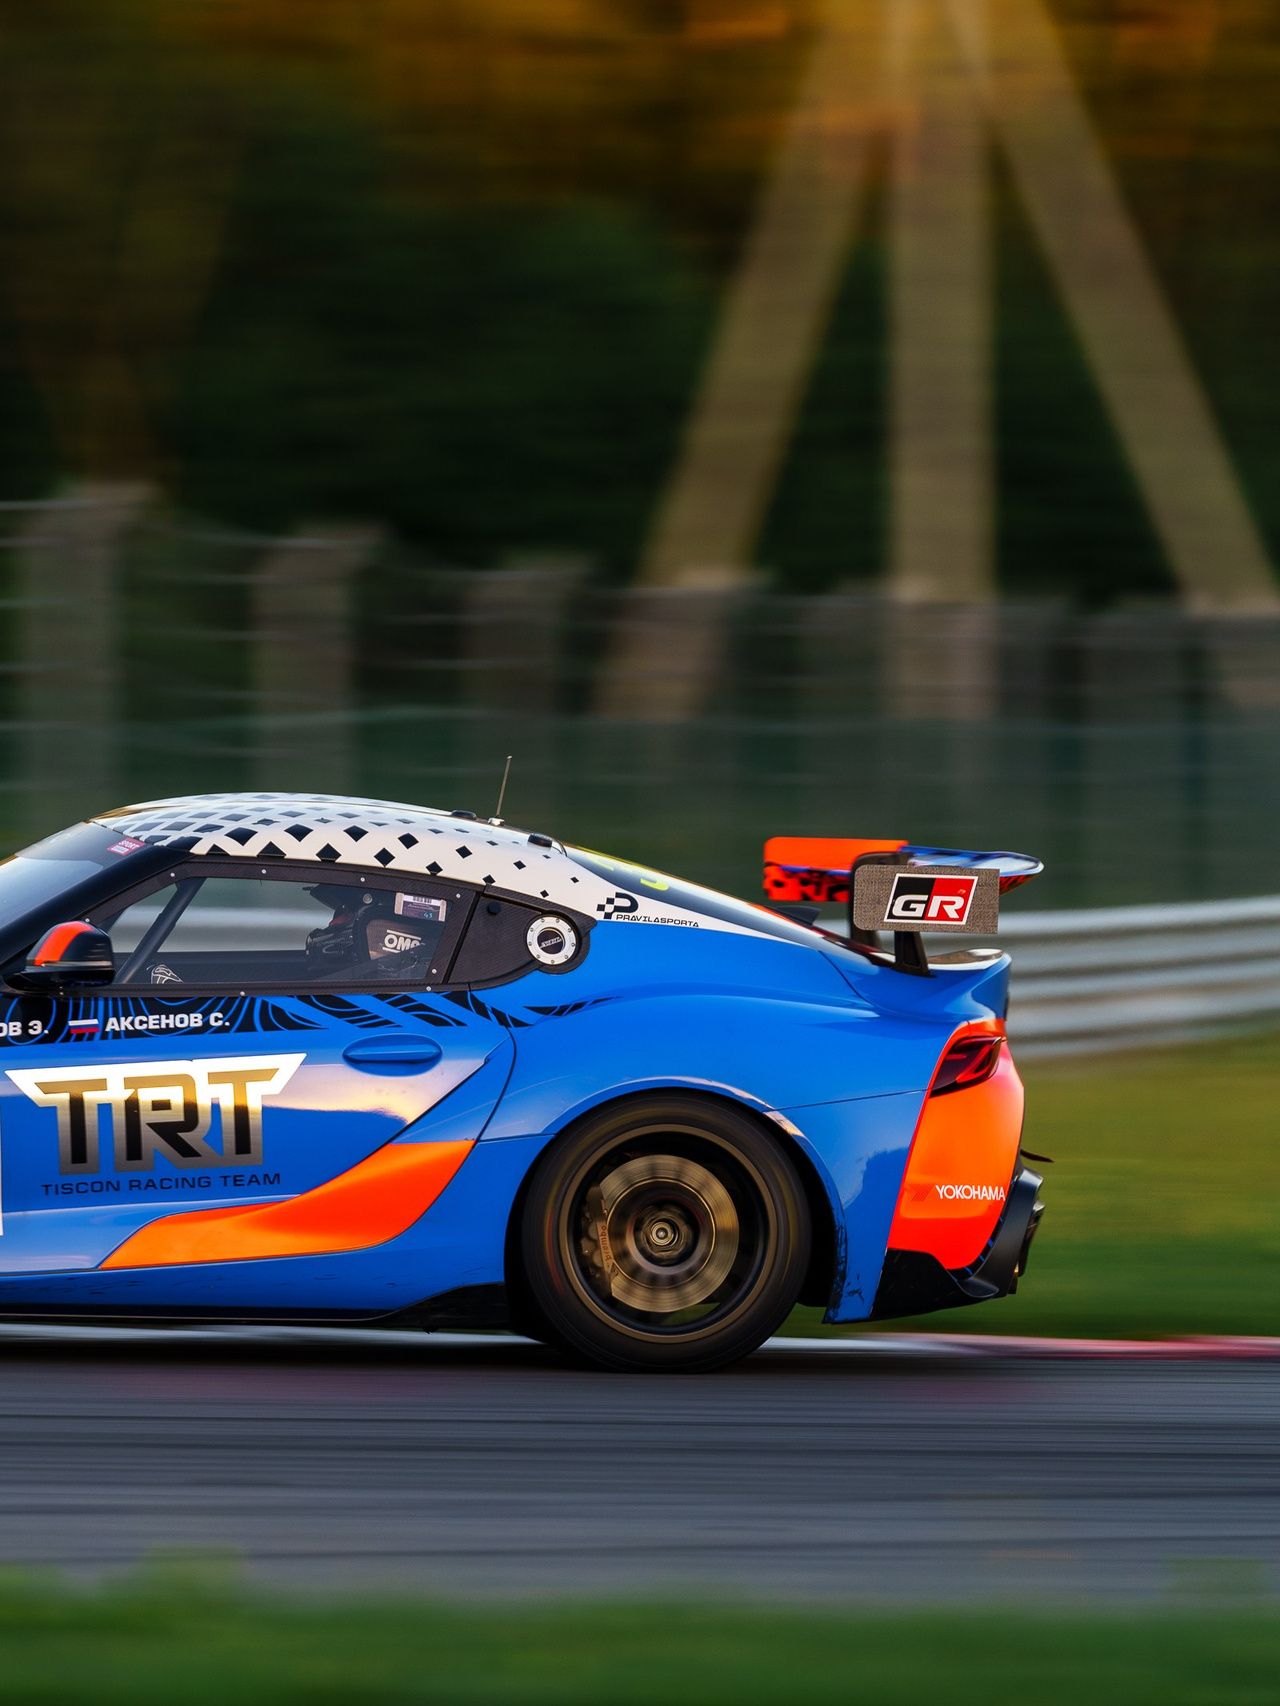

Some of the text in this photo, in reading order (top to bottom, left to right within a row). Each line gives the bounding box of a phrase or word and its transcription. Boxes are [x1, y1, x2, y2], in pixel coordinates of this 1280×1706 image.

[892, 894, 965, 919] GR
[616, 914, 700, 928] PRAVILASPORTA
[28, 1020, 49, 1035] Э.
[105, 1012, 230, 1032] АКСЕНОВ С.
[4, 1052, 307, 1176] TRT
[42, 1173, 281, 1196] TISCON RACING TEAM
[935, 1185, 1006, 1202] YOKOHAMA
